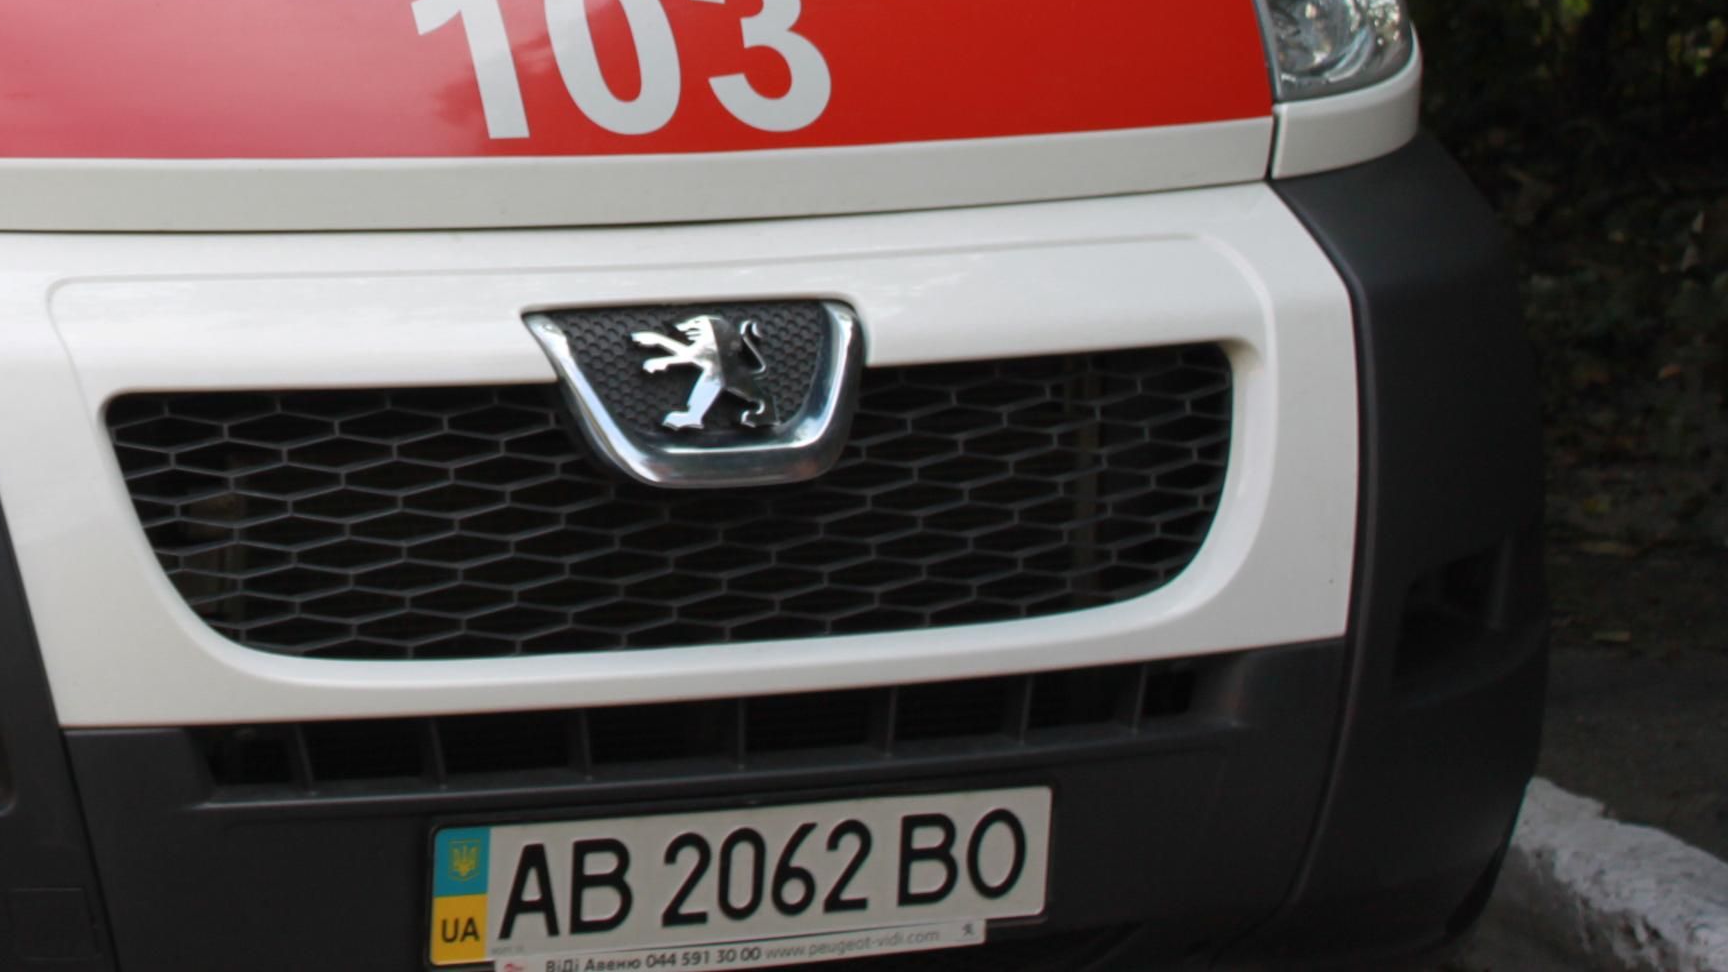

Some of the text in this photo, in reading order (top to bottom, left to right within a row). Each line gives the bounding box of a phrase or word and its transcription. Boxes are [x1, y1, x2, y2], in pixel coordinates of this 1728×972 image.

[498, 807, 1027, 940] AB 2062 BO
[441, 917, 480, 943] UA
[585, 957, 641, 972] Авеню
[645, 953, 677, 969] 044
[681, 950, 710, 966] 591
[716, 948, 737, 963] 30
[740, 946, 762, 961] 00
[765, 929, 940, 959] www.peugeot-vidi.com
